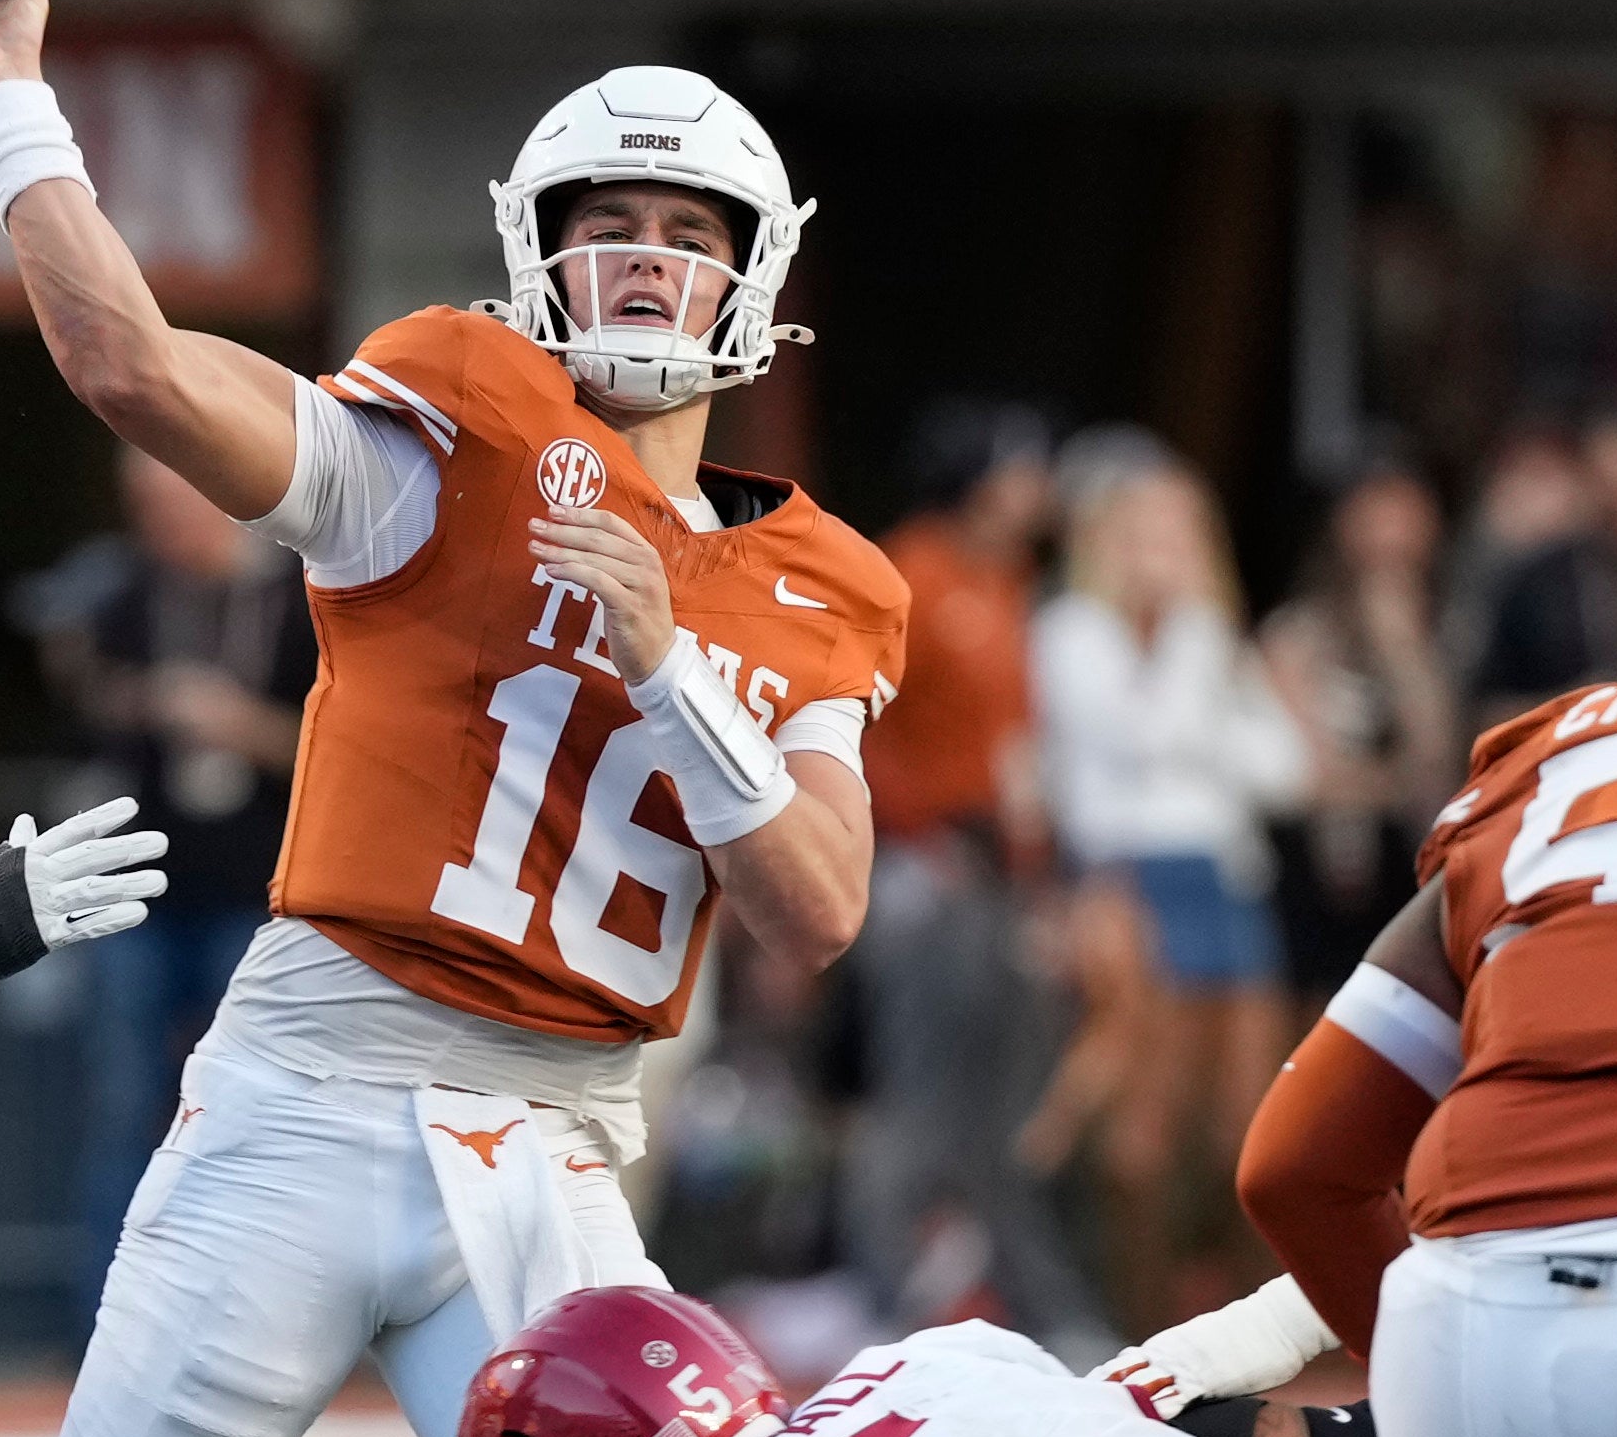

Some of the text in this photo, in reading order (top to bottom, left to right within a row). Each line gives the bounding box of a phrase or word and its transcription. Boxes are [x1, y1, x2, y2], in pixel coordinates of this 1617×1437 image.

[620, 133, 681, 152] HORNS
[542, 441, 601, 507] SEC
[429, 663, 707, 1008] 16
[666, 1362, 733, 1431] 5
